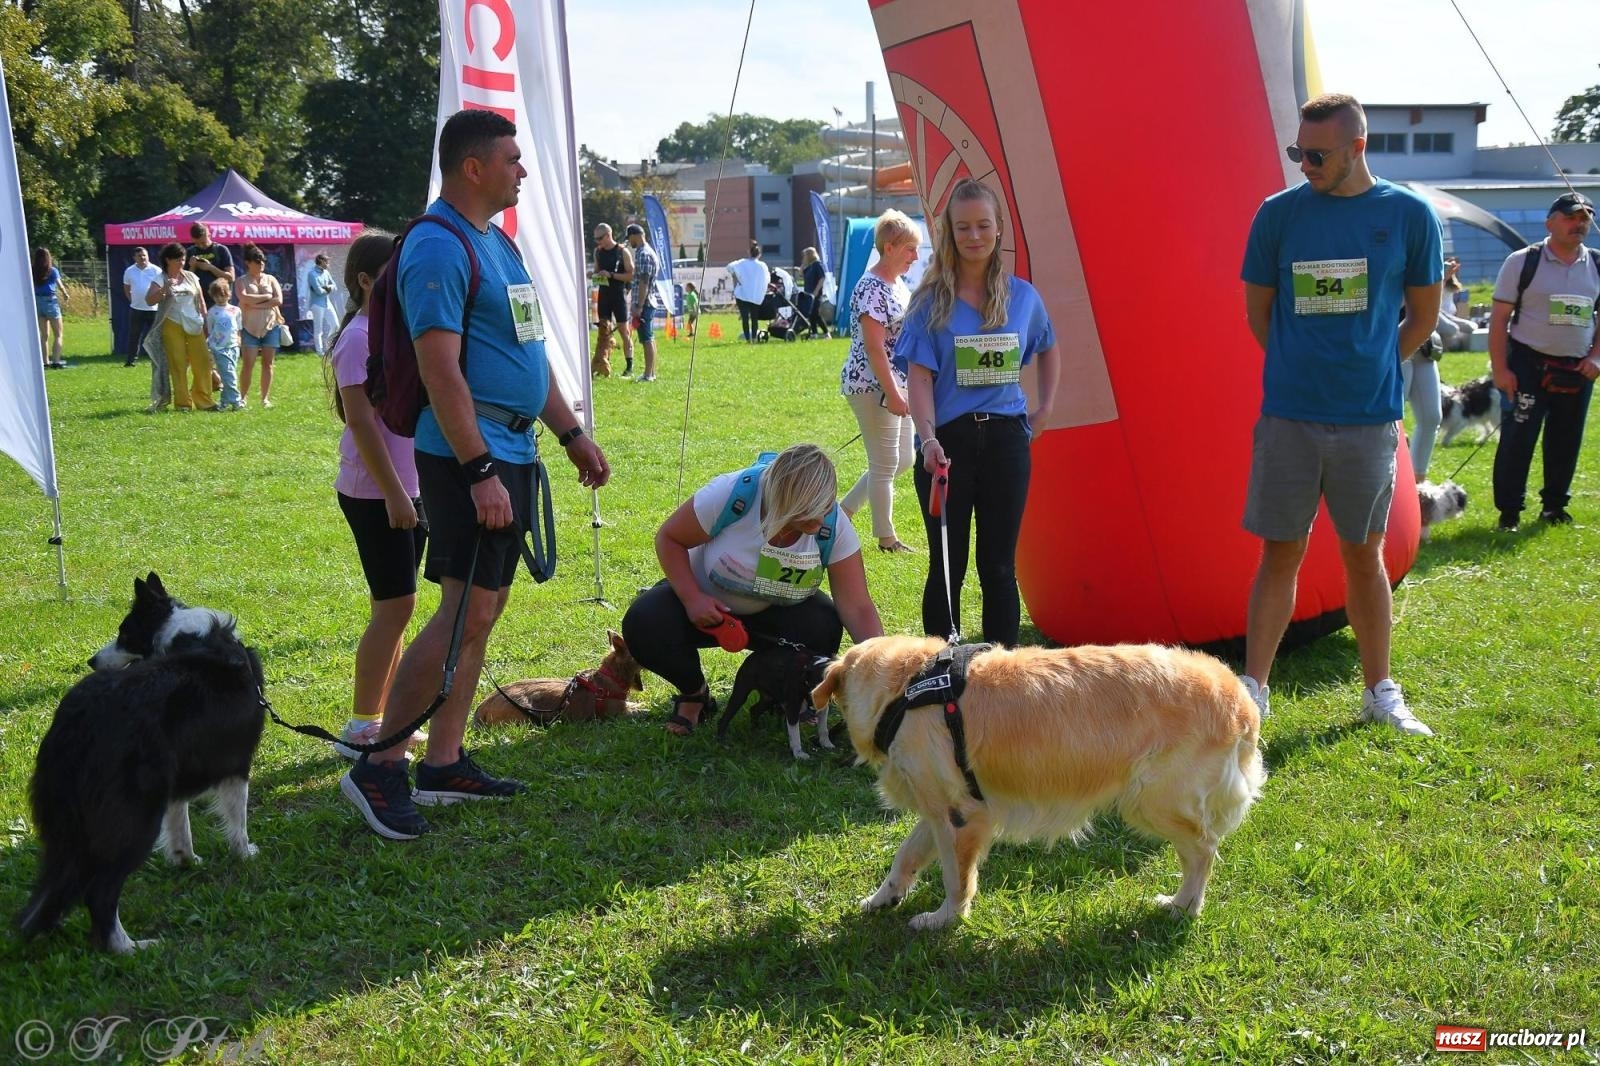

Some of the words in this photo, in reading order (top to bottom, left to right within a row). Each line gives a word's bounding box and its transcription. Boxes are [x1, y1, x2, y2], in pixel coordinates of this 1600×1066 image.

[122, 227, 143, 240] 100%
[143, 226, 177, 239] NATURAL
[210, 225, 240, 238] 75%
[243, 225, 295, 239] ANIMAL
[297, 225, 352, 239] PROTEIN
[1315, 278, 1344, 296] 54
[1564, 305, 1581, 315] 52
[978, 351, 1004, 368] 48
[779, 567, 807, 585] 27
